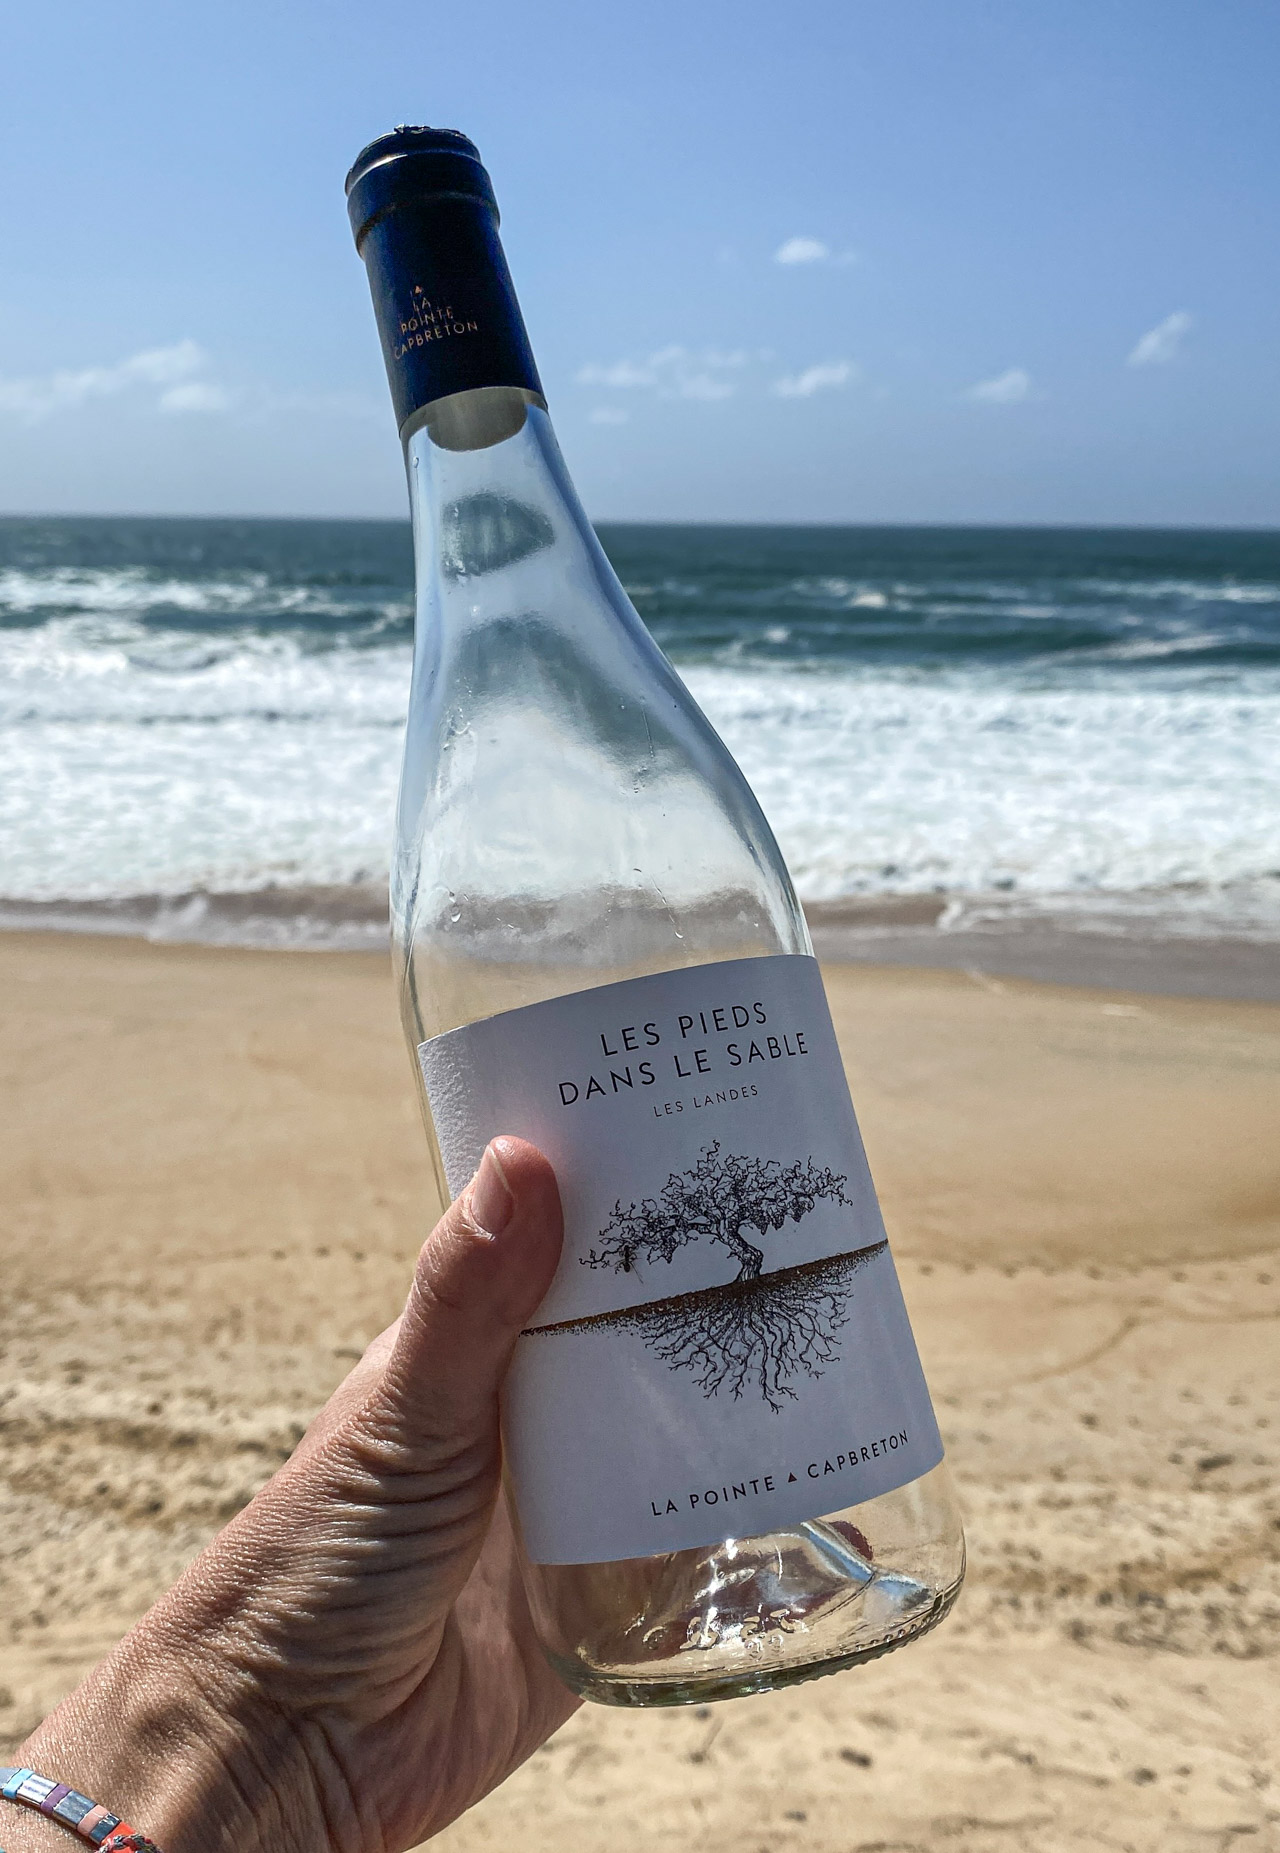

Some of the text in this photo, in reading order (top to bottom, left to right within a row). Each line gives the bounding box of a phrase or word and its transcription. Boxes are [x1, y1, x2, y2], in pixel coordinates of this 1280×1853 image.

[394, 321, 479, 360] CAPBRETON
[401, 306, 454, 335] POINTE
[600, 1001, 767, 1057] LES PIEDS
[558, 1032, 809, 1106] DANS LE SABLE
[653, 1084, 759, 1118] LES LANDES
[651, 1429, 909, 1517] LA POINTE CAPBRETON
